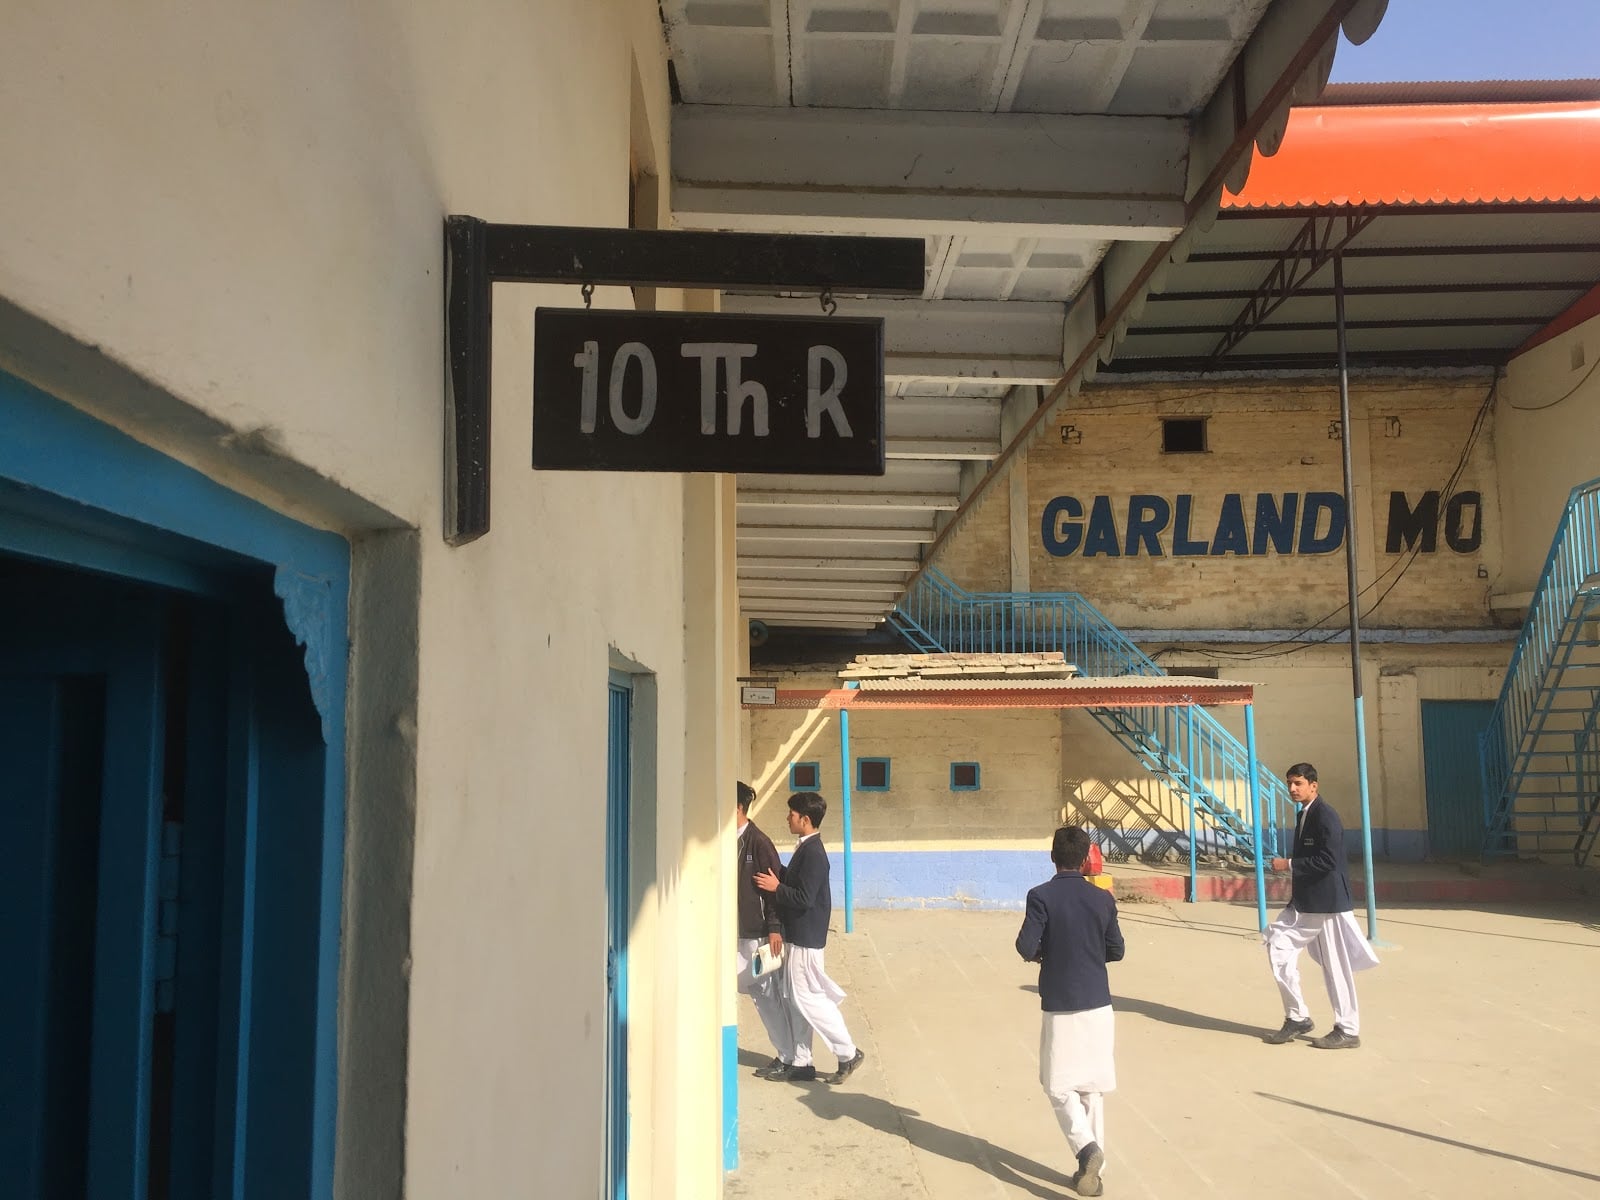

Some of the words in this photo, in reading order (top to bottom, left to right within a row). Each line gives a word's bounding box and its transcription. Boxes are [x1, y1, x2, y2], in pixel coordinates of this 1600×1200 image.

[574, 341, 657, 435] 10
[681, 342, 770, 436] Th
[805, 344, 854, 438] R
[1041, 492, 1347, 557] GARLAND
[1385, 491, 1482, 554] MO
